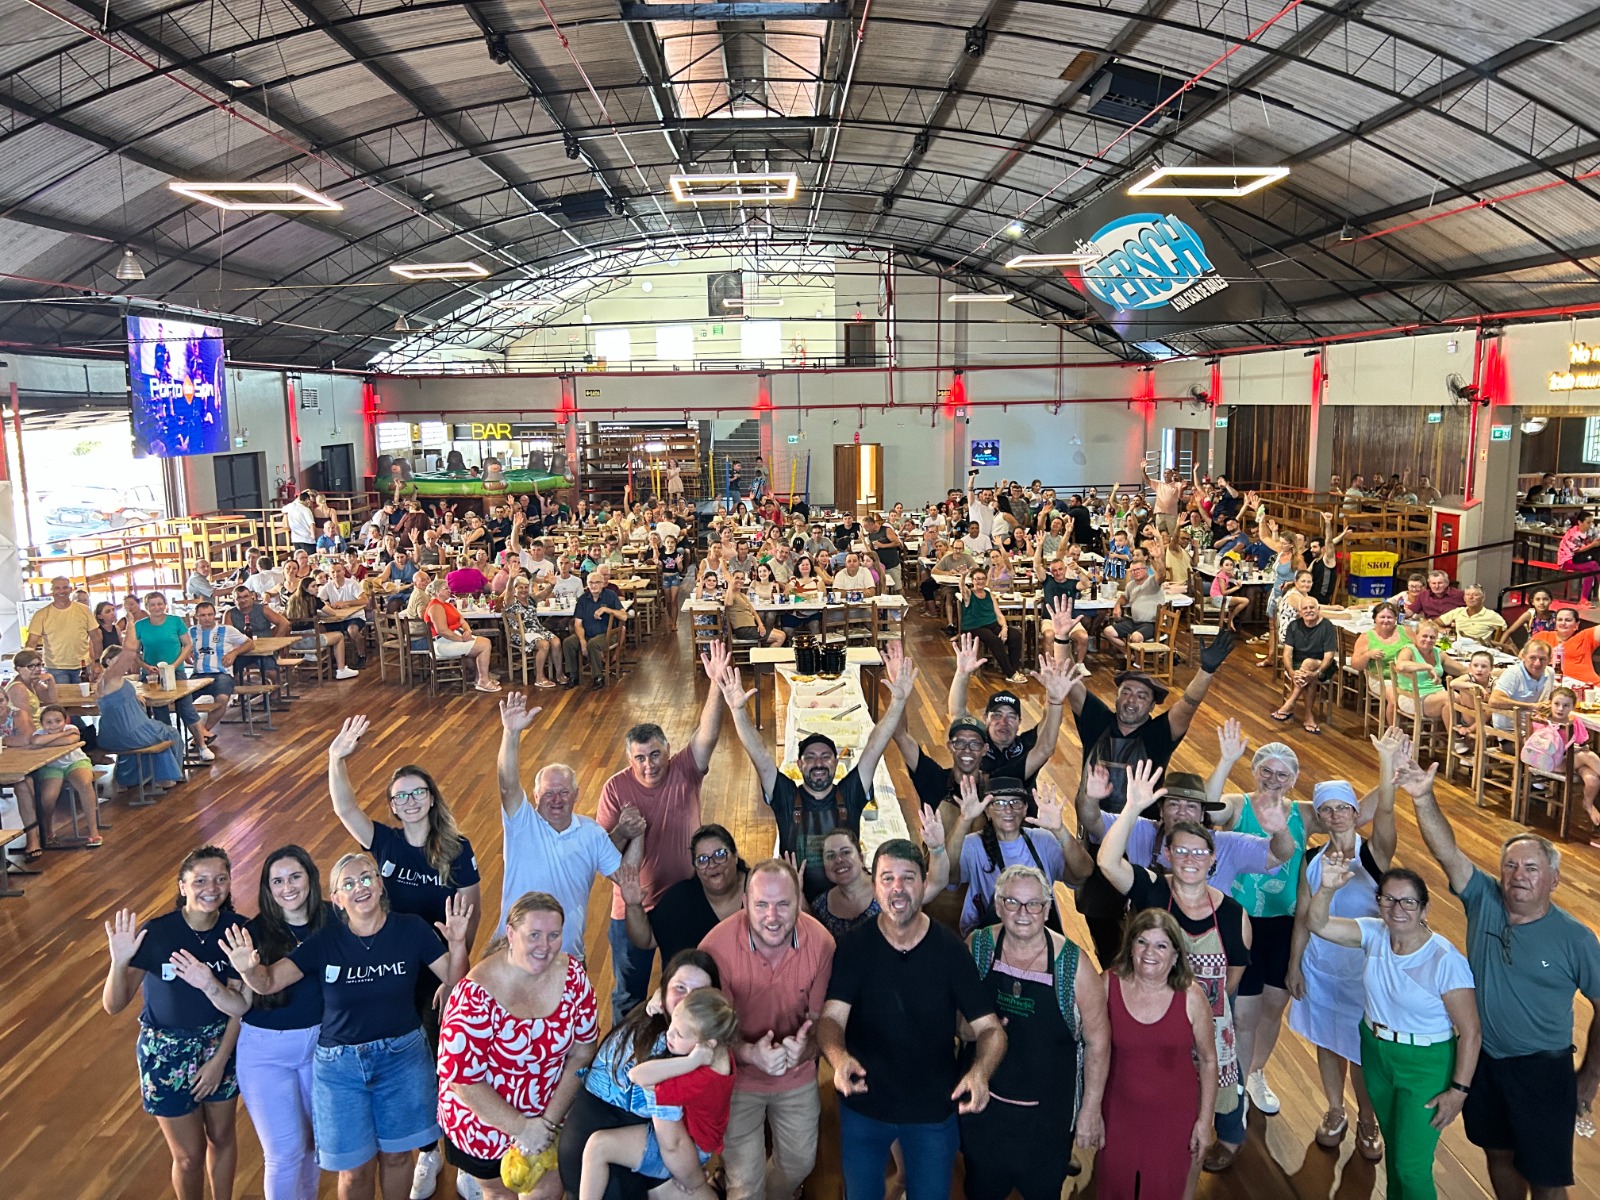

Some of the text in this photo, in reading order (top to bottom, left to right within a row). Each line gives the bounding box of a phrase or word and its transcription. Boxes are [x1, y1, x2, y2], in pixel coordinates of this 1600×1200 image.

[1084, 213, 1216, 313] PERSCH
[471, 422, 513, 440] BAR
[1367, 561, 1392, 569] SKOL
[346, 961, 407, 980] LUMME
